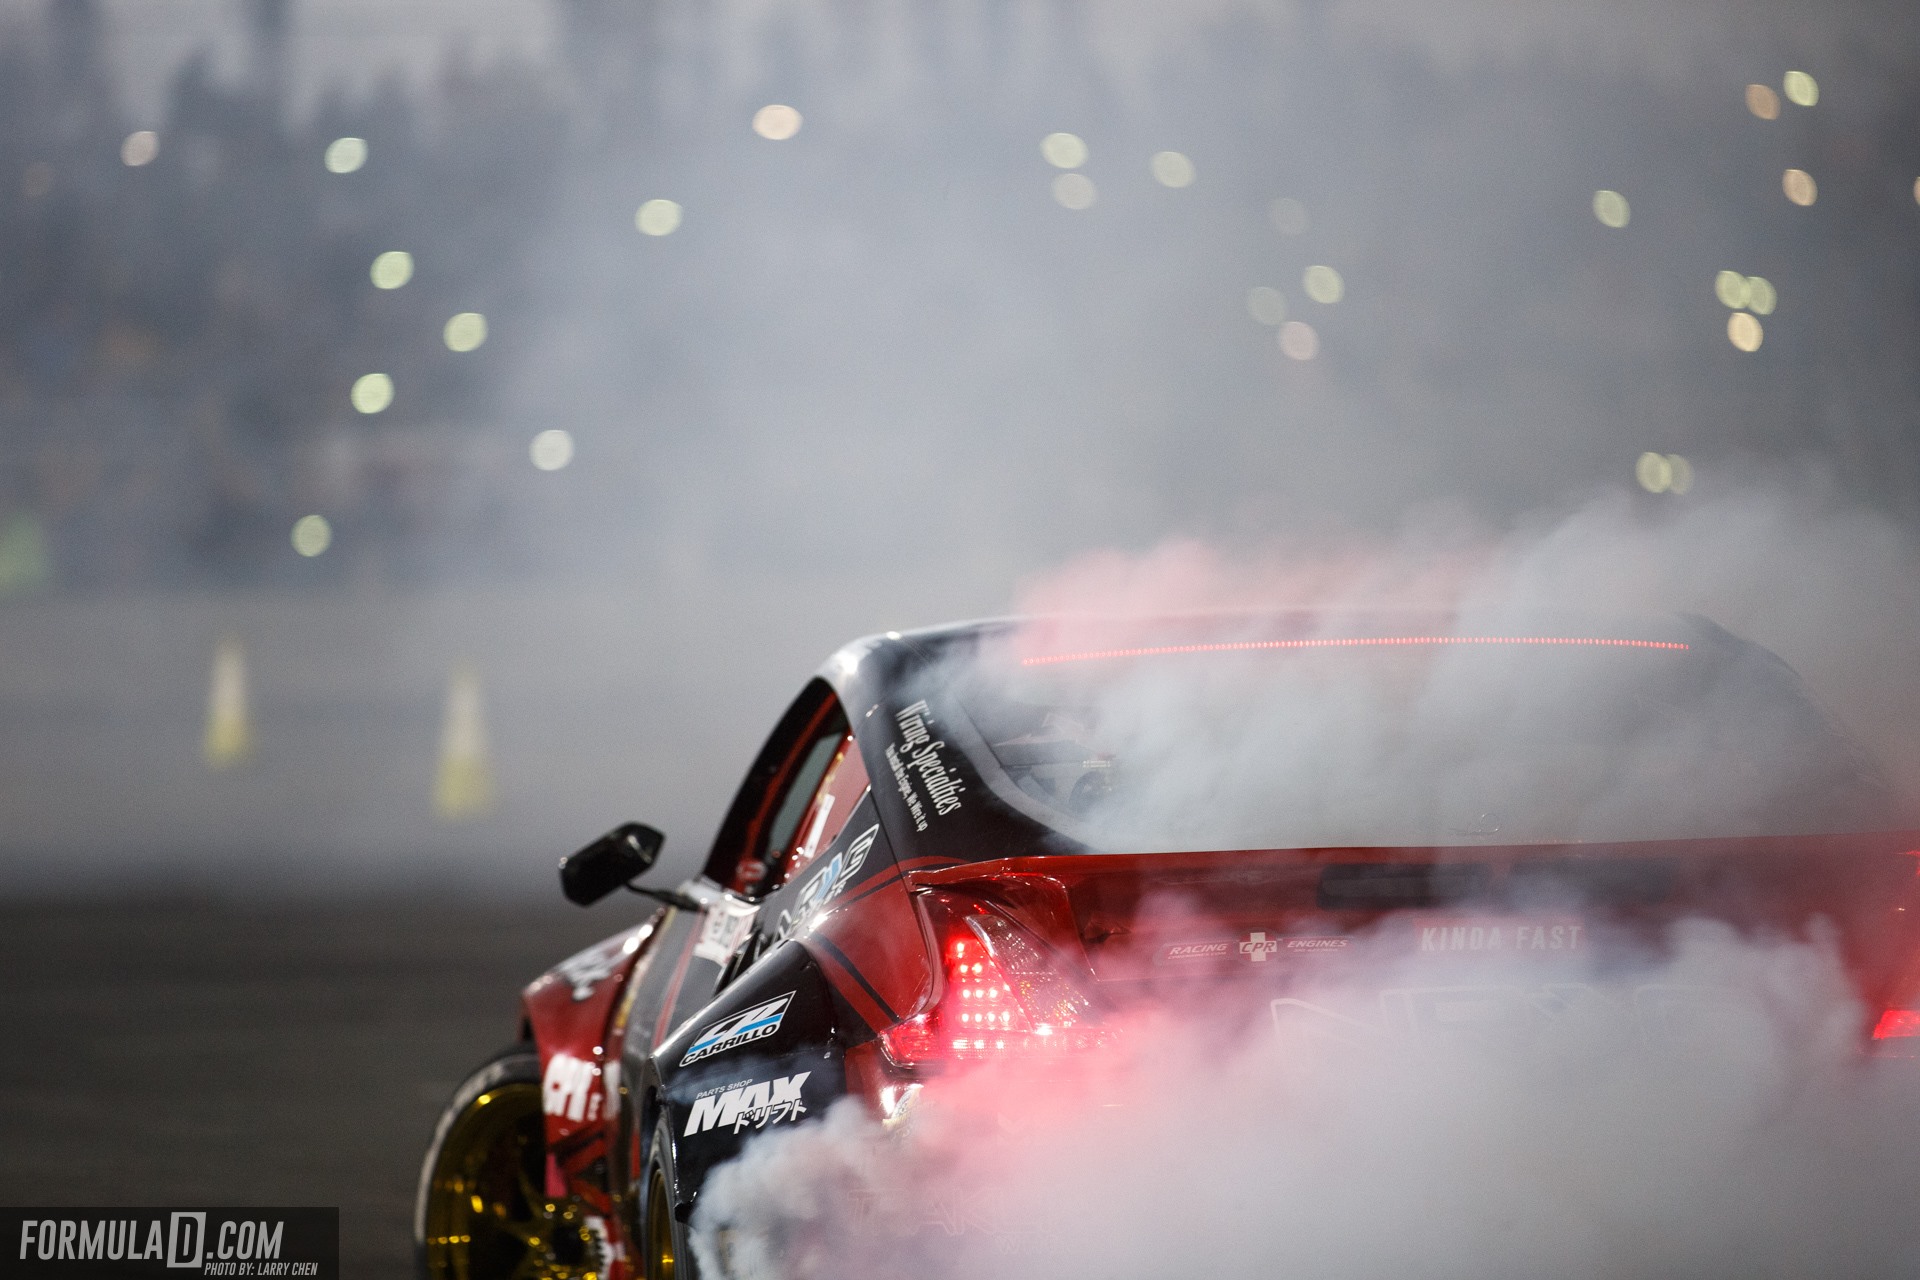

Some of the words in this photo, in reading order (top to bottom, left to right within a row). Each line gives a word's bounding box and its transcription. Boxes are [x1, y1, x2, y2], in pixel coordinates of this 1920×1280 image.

[895, 699, 935, 753] Wiring
[907, 741, 966, 816] Specialties
[906, 792, 918, 807] We
[910, 800, 923, 819] Wire
[915, 813, 926, 825] it
[917, 819, 928, 832] up
[1169, 943, 1228, 955] RACING
[1241, 942, 1275, 953] CPR
[1287, 940, 1348, 948] ENGINES
[1421, 927, 1501, 951] KINDA
[1516, 926, 1582, 950] FAST
[682, 1023, 777, 1063] CARRILLO
[696, 1085, 725, 1100] PARTS
[727, 1078, 753, 1091] SHOP
[683, 1071, 812, 1137] MAX
[733, 1099, 807, 1135] ドリフト
